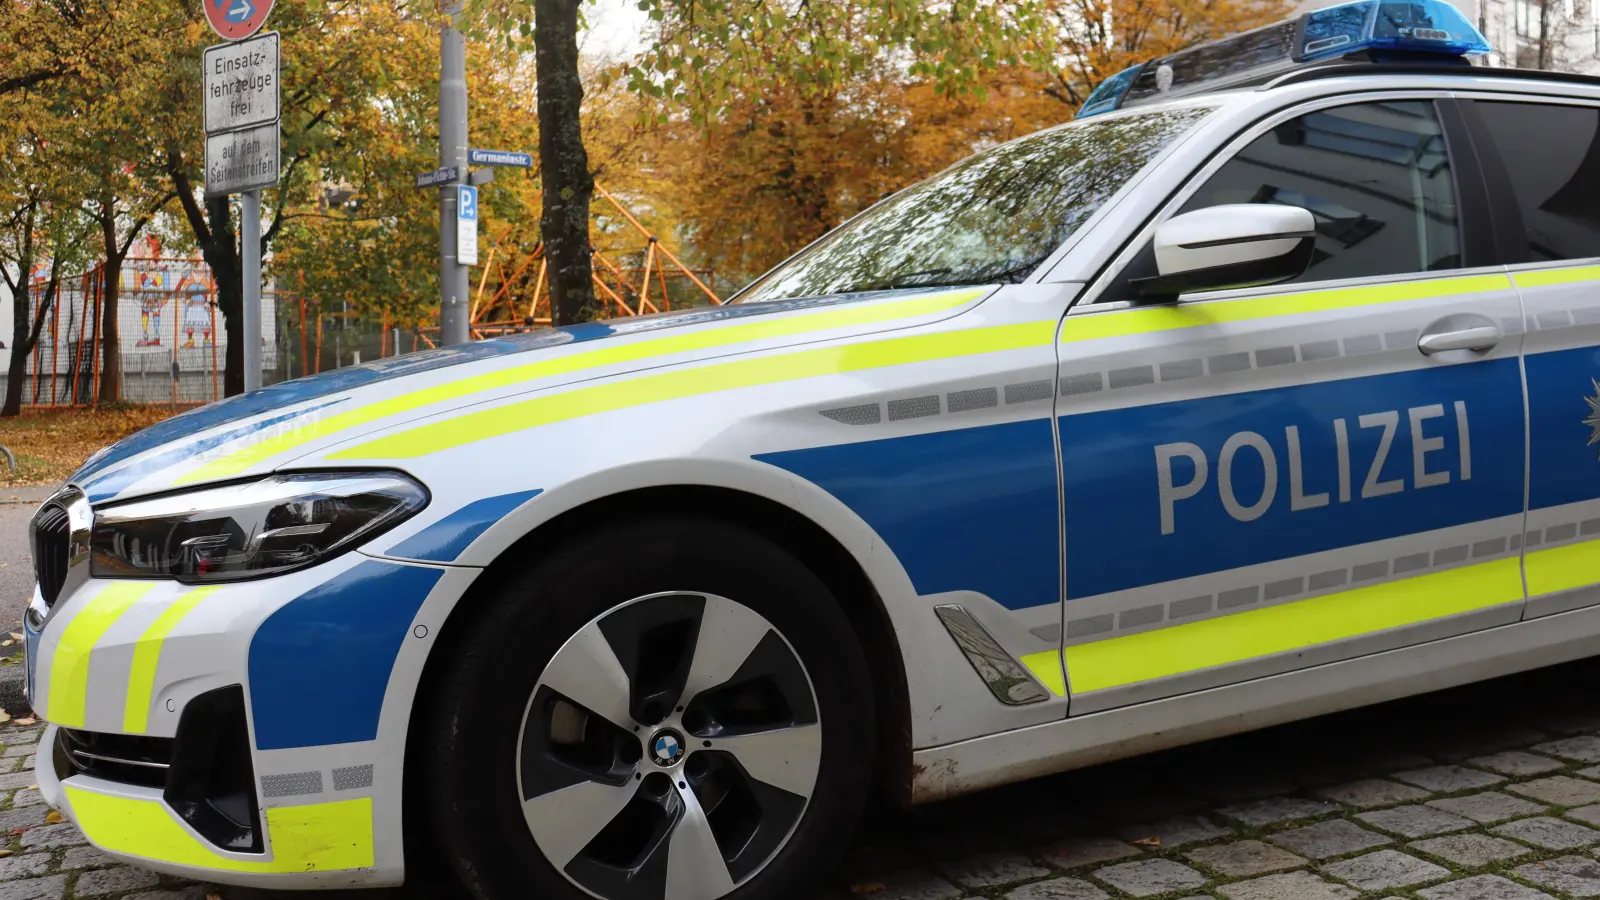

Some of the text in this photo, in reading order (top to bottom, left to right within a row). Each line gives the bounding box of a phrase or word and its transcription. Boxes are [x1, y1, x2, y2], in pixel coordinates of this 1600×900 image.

[215, 52, 266, 75] Einsatz-
[210, 74, 272, 99] fahrzeuge
[230, 98, 251, 118] frei
[222, 139, 260, 159] auf dem
[472, 151, 528, 165] Germaniastr.
[210, 159, 273, 184] Seitenstreifen
[461, 190, 472, 216] P
[1154, 400, 1471, 535] POLIZEI
